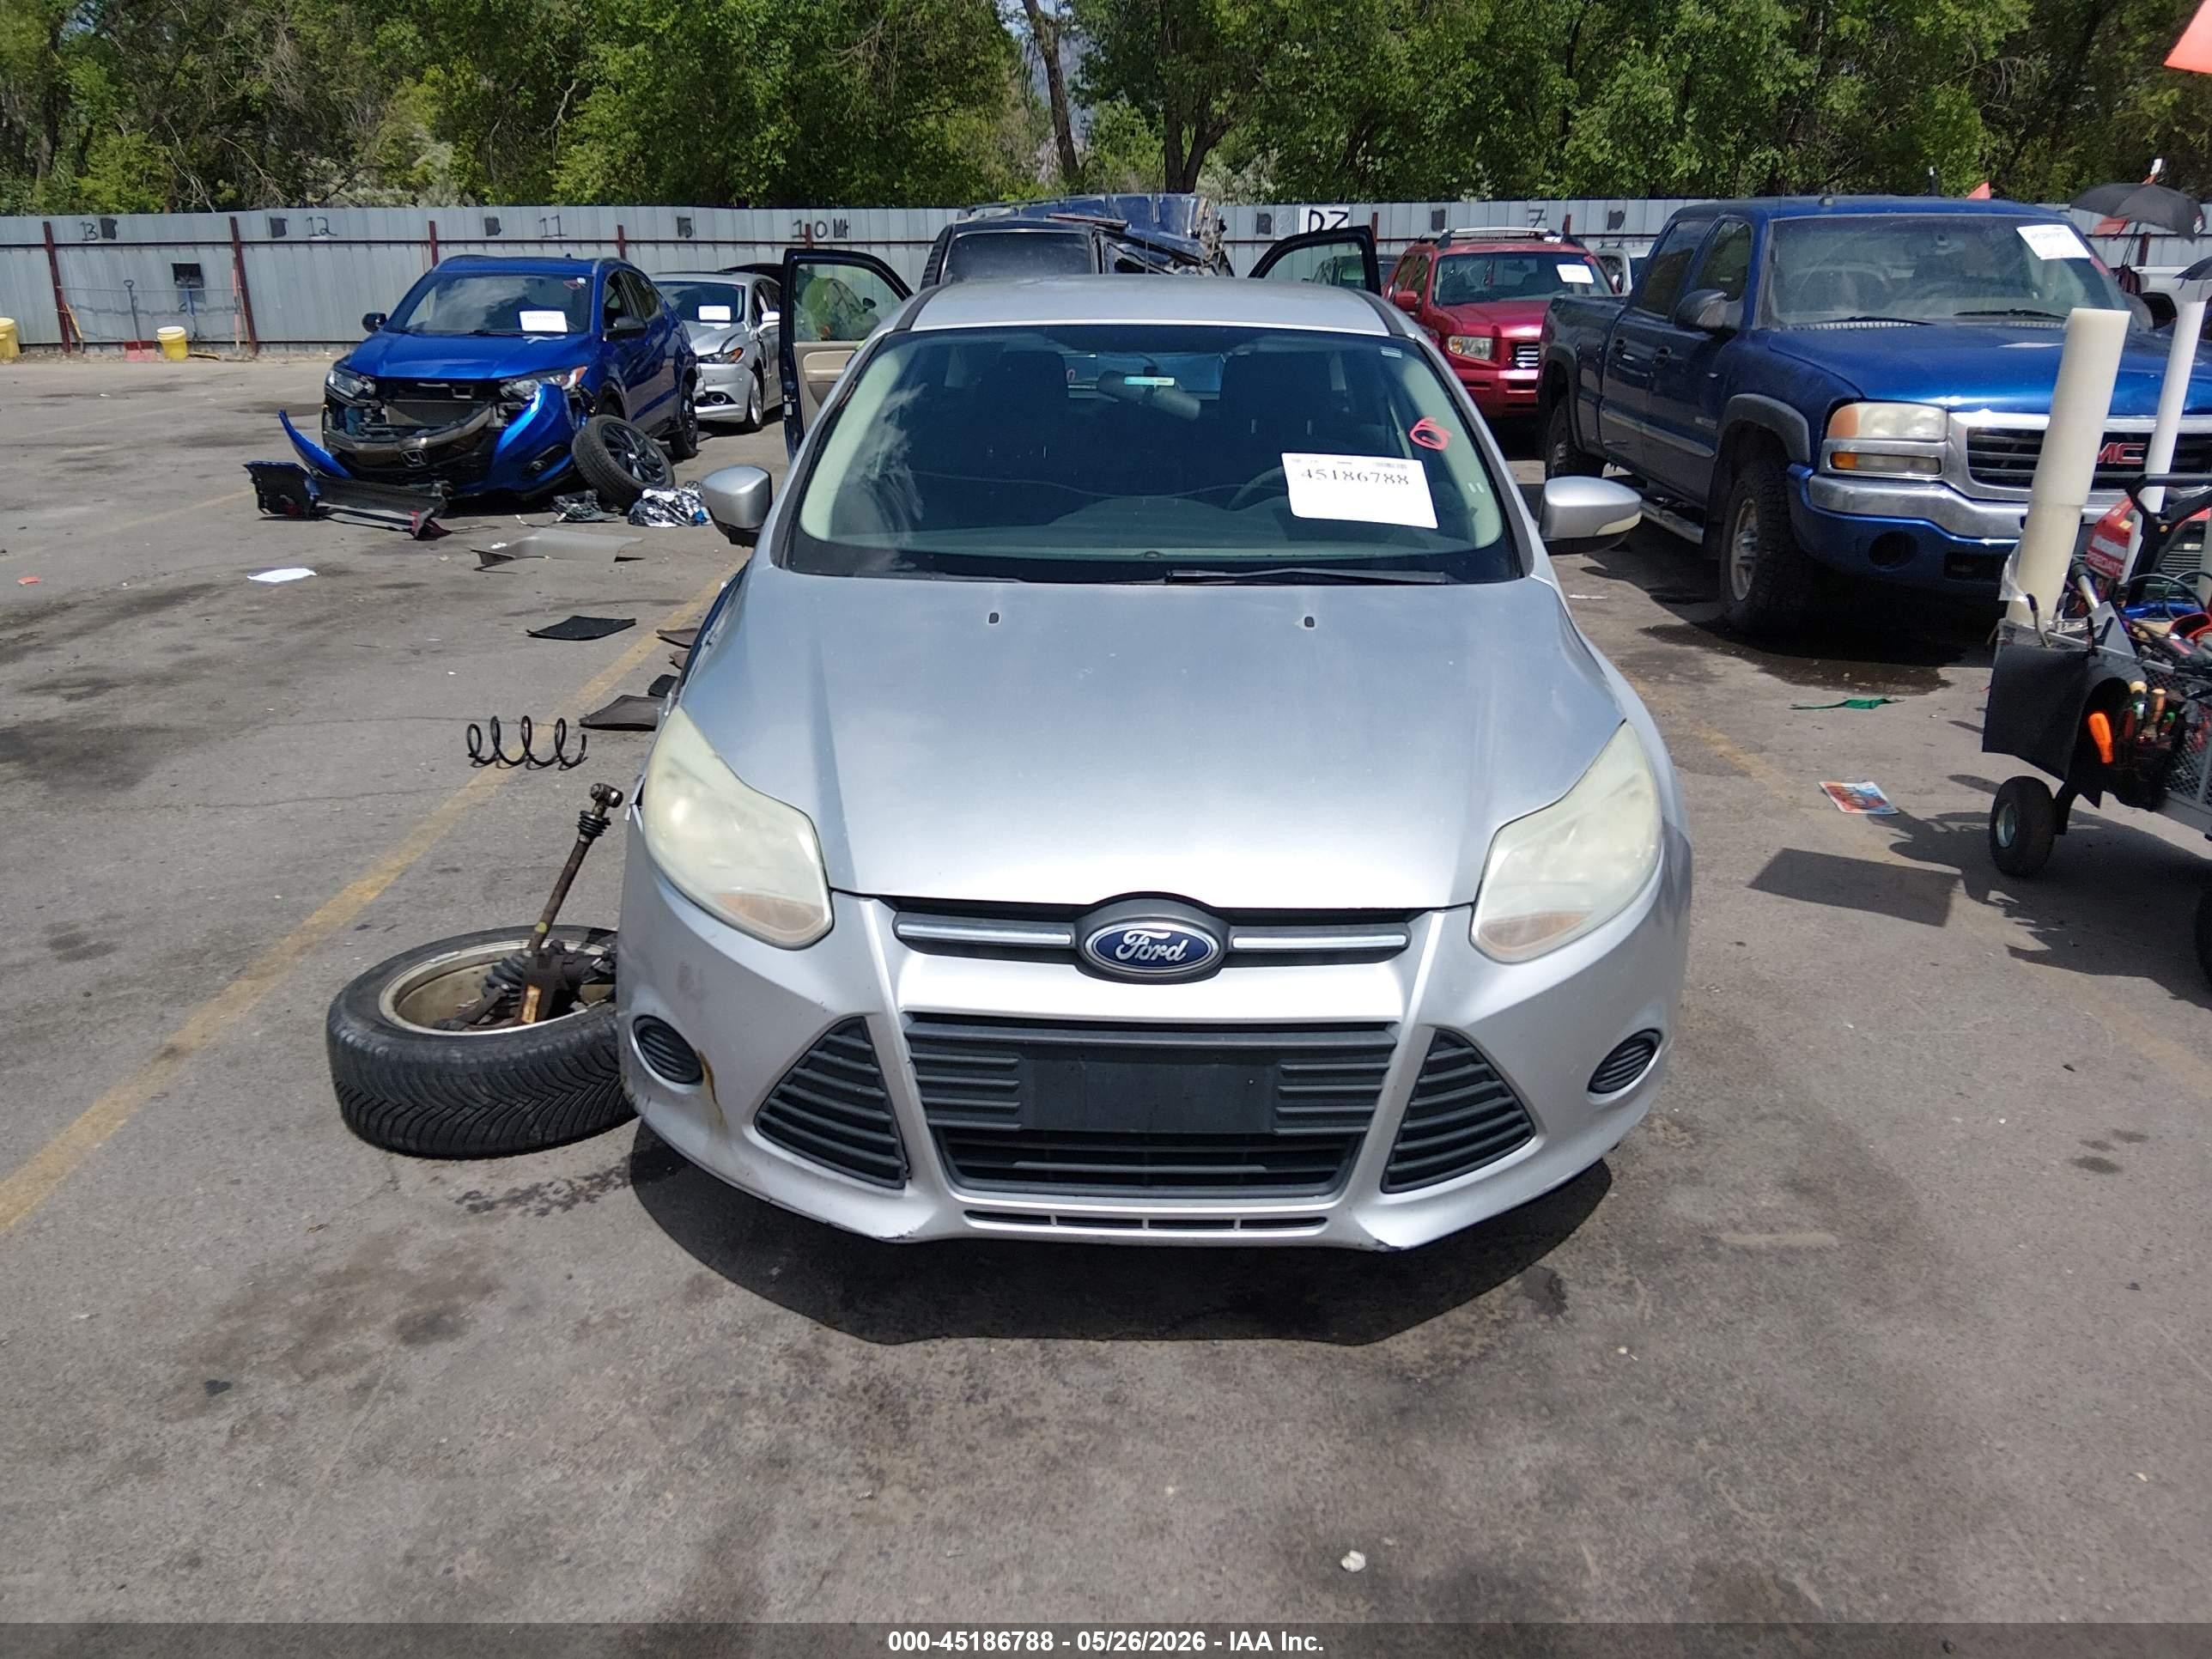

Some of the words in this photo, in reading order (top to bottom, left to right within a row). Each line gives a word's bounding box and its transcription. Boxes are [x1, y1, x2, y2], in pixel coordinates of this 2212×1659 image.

[306, 216, 337, 236] 12
[538, 215, 567, 238] 11
[1528, 209, 1547, 228] 7
[792, 219, 828, 238] 10
[1301, 468, 1409, 486] 45186788
[1115, 930, 1188, 962] Ford
